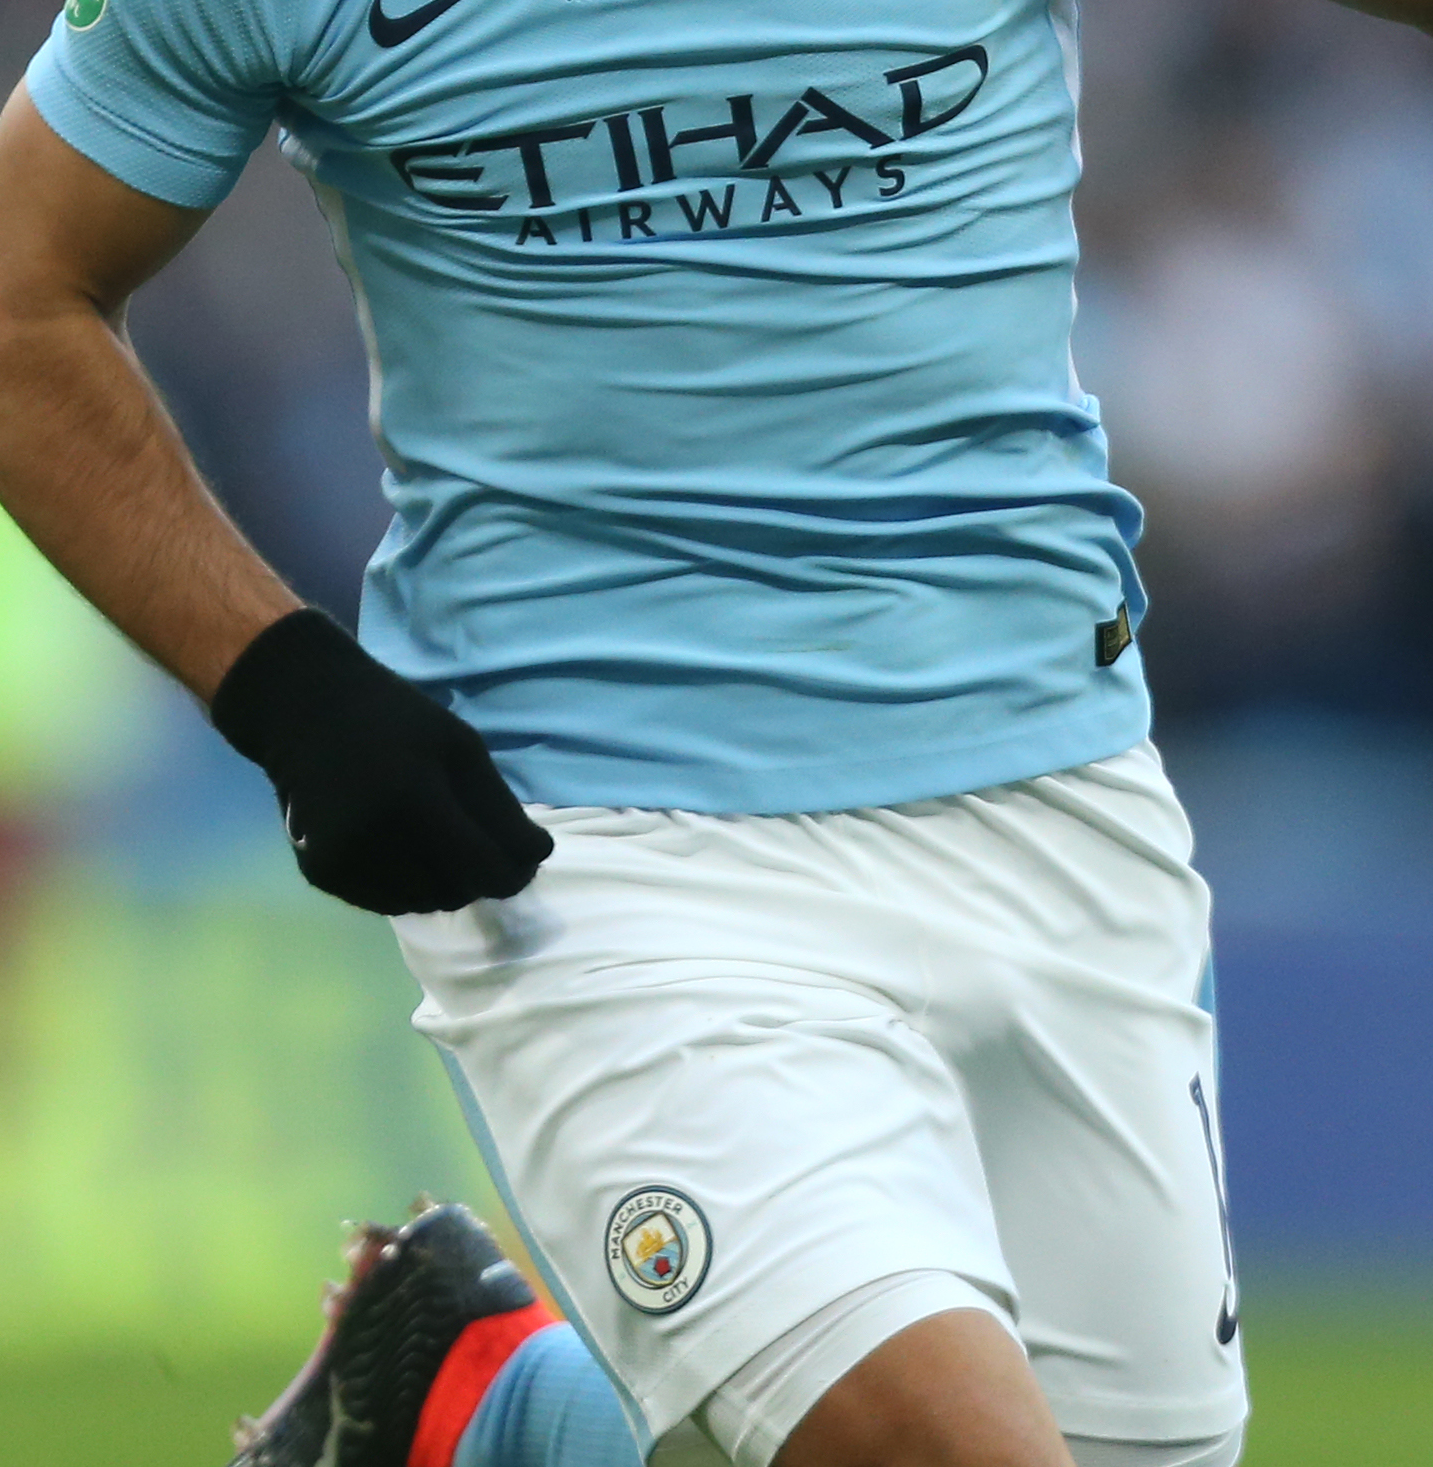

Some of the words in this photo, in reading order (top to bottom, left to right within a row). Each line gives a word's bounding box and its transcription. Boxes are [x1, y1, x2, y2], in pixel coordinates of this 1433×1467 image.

[389, 44, 988, 211] ETIHAD
[516, 153, 906, 245] AIRWAYS
[611, 1196, 683, 1260] MANCHESTER
[662, 1277, 689, 1303] CITY
